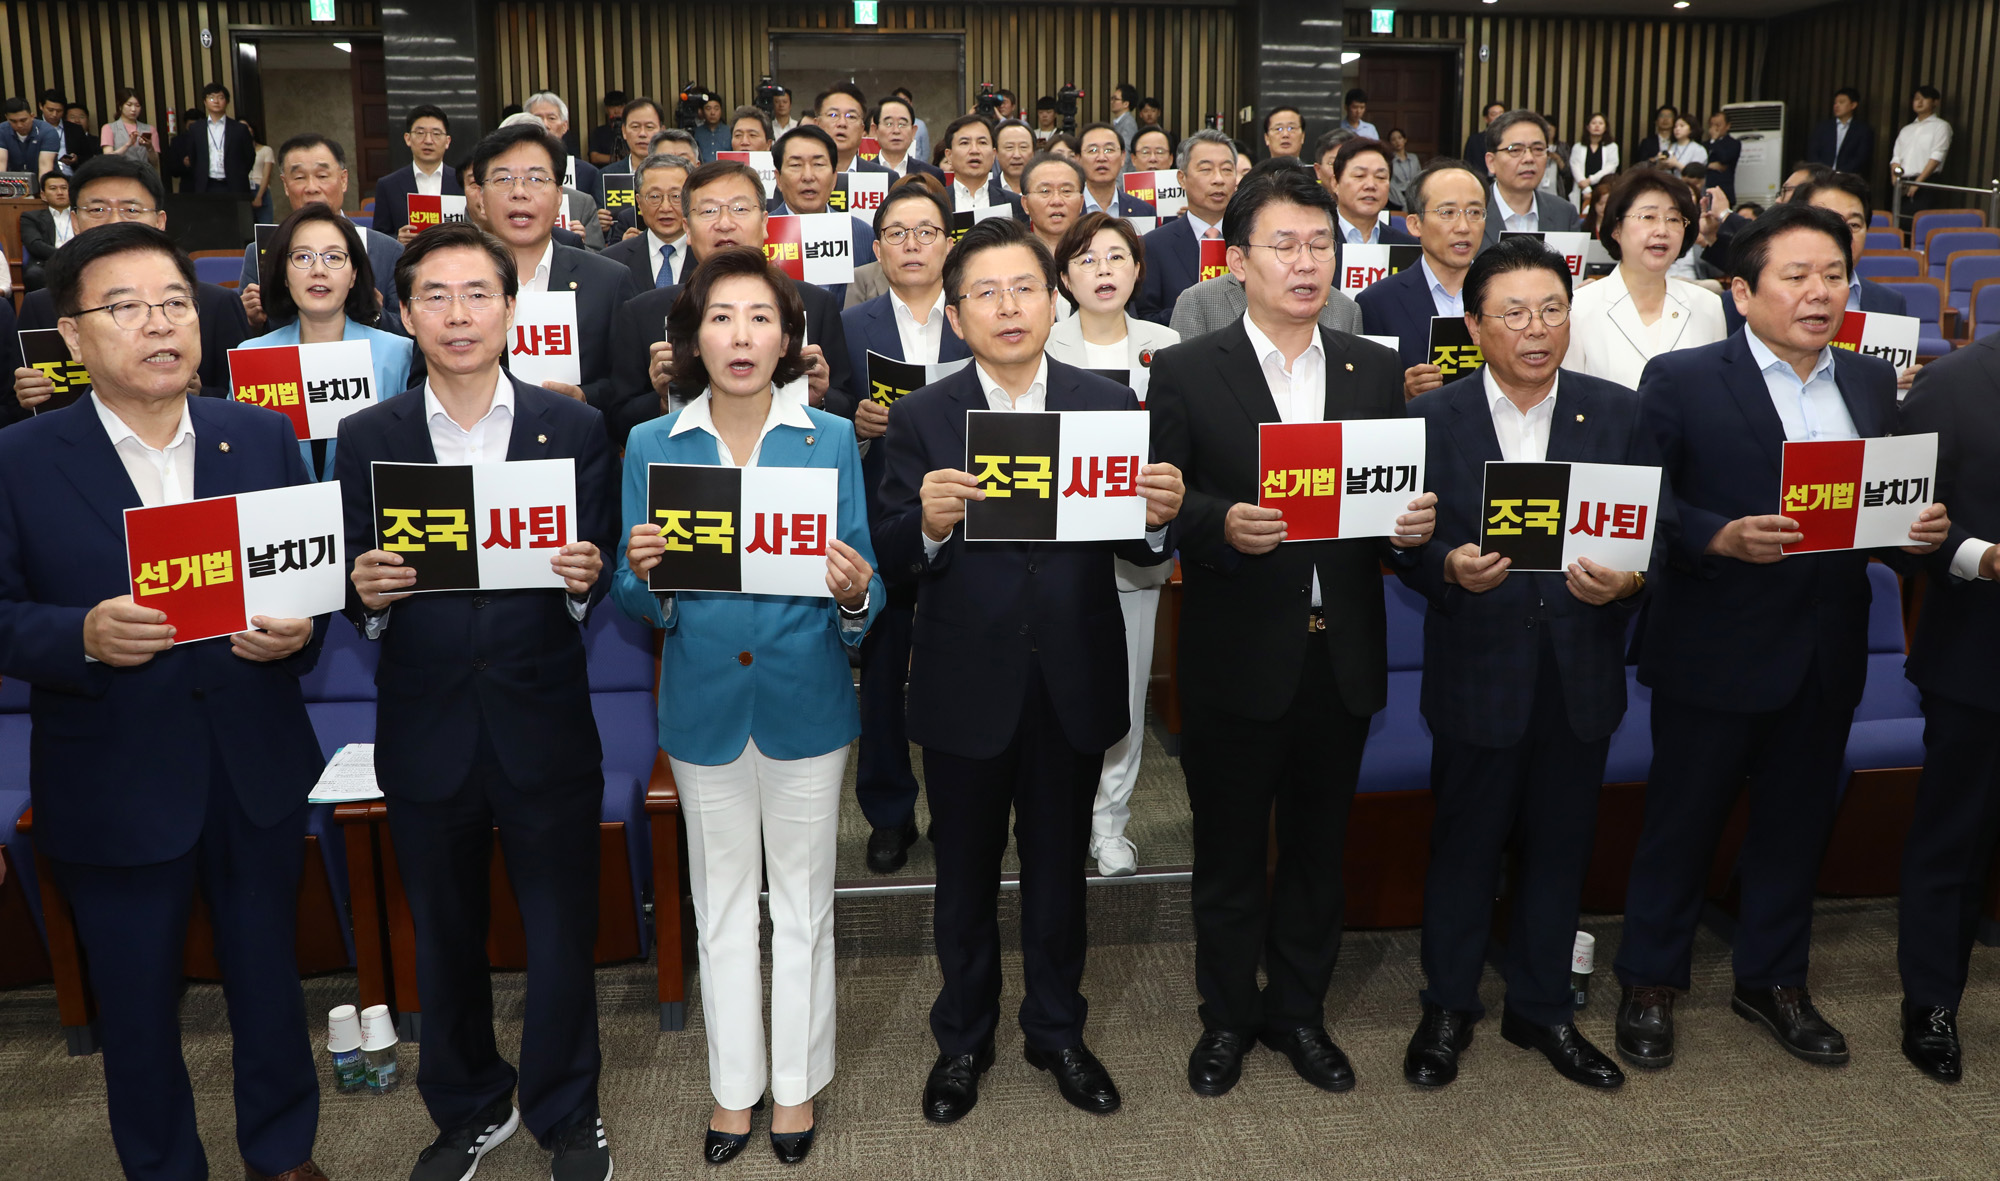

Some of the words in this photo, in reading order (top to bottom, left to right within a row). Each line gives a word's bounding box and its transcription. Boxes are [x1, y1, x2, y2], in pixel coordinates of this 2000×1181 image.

[828, 190, 847, 210] 국
[851, 191, 884, 210] 사퇴
[409, 211, 440, 225] 선거법
[804, 240, 849, 259] 날치기
[511, 324, 572, 357] 사퇴
[1432, 344, 1485, 375] 조국
[236, 381, 300, 408] 선거법
[307, 376, 371, 404] 날치기
[973, 454, 1053, 499] 조국
[1062, 454, 1140, 499] 사퇴
[1261, 467, 1336, 499] 선거법
[1345, 464, 1418, 495] 날치기
[1783, 481, 1855, 512] 선거법
[1863, 477, 1929, 508] 날치기
[382, 507, 469, 552] 조국
[481, 504, 567, 550] 사퇴
[655, 509, 735, 554] 조국
[745, 512, 828, 557] 사퇴
[1486, 498, 1561, 536] 조국
[1568, 500, 1649, 541] 사퇴
[134, 550, 235, 597] 선거법
[247, 533, 336, 579] 날치기
